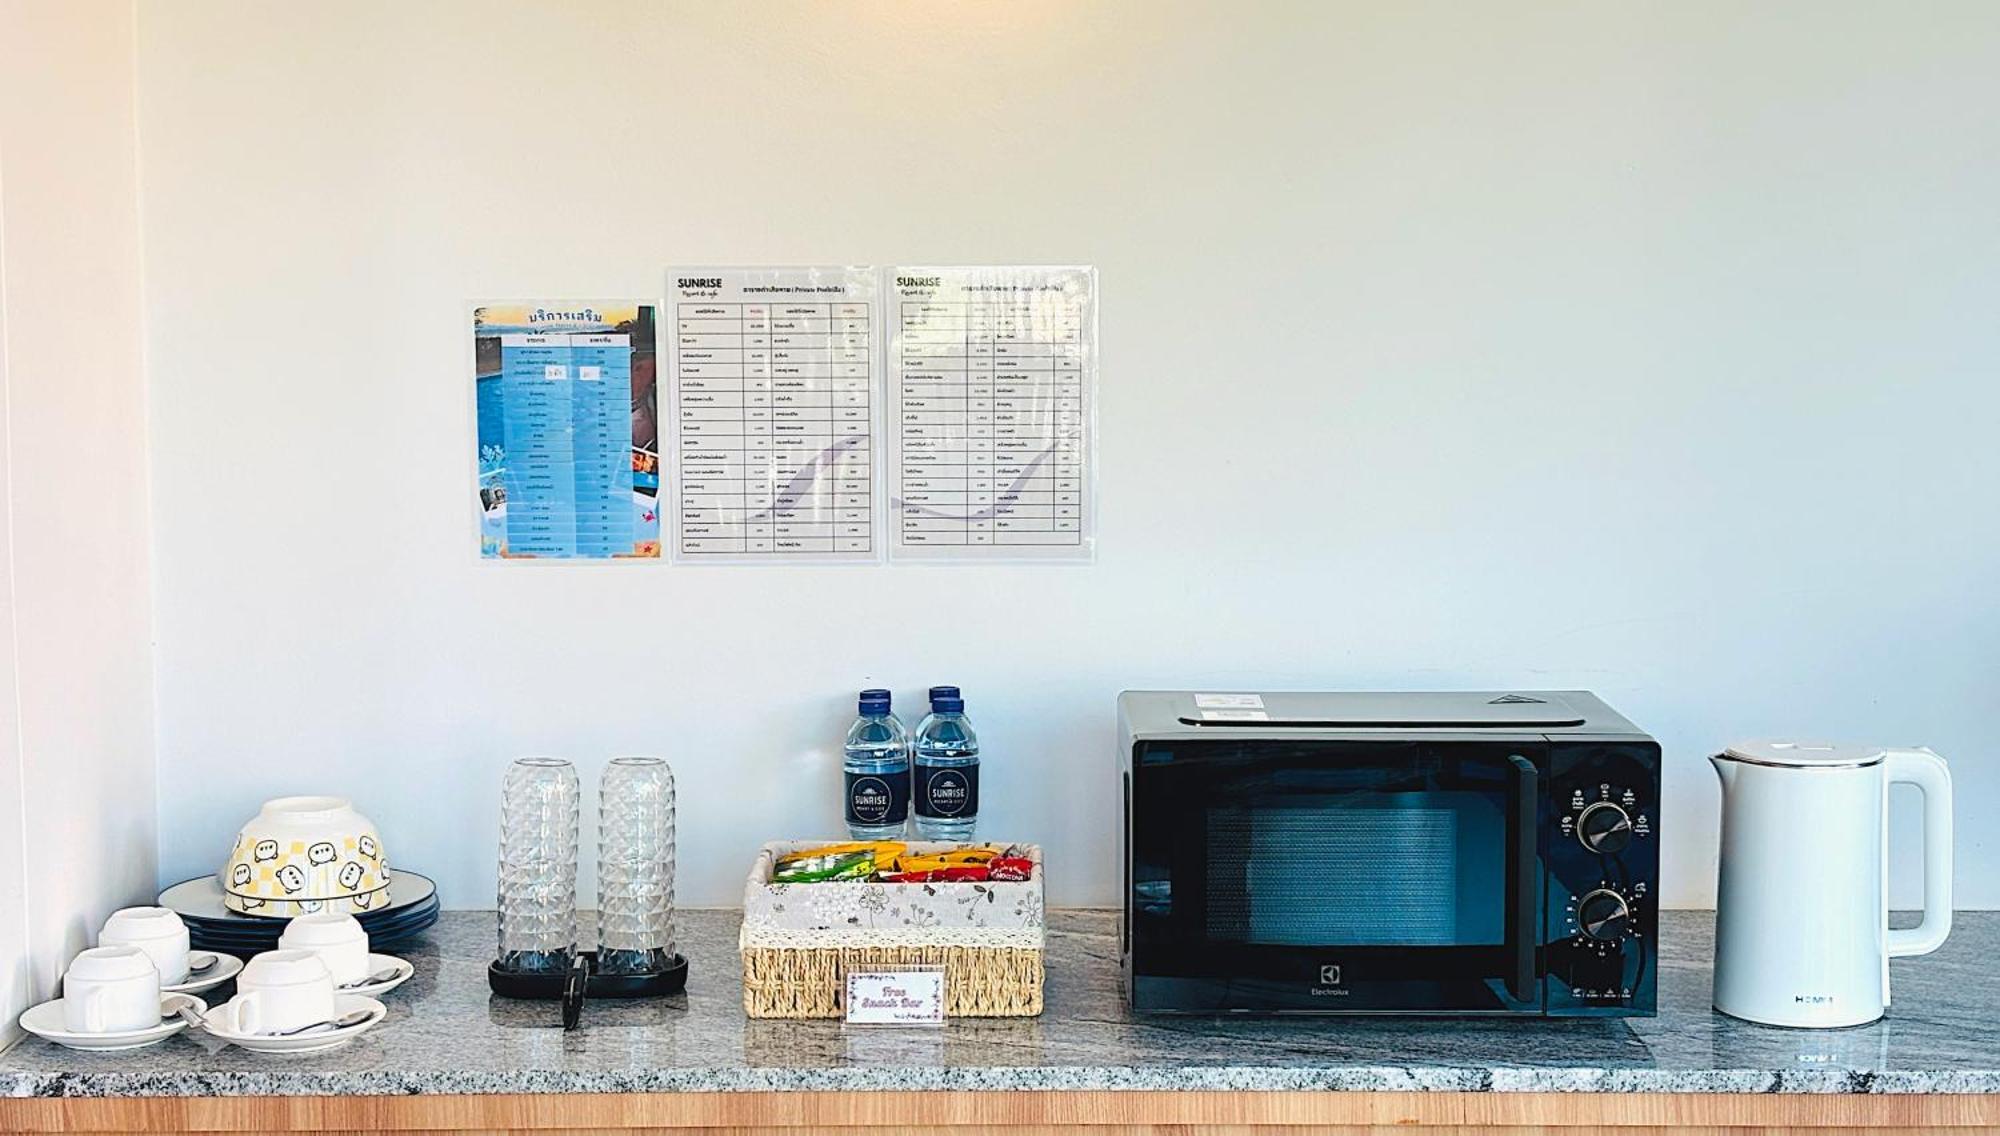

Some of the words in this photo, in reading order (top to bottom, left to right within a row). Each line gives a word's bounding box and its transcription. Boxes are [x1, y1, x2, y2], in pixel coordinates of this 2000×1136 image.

[677, 278, 722, 288] SUNRISE
[896, 276, 941, 287] SUNRISE
[529, 308, 602, 322] บริการเสริม
[932, 788, 965, 798] SUNRISE
[855, 795, 887, 805] SUNRISE
[1311, 988, 1349, 996] Electrolux
